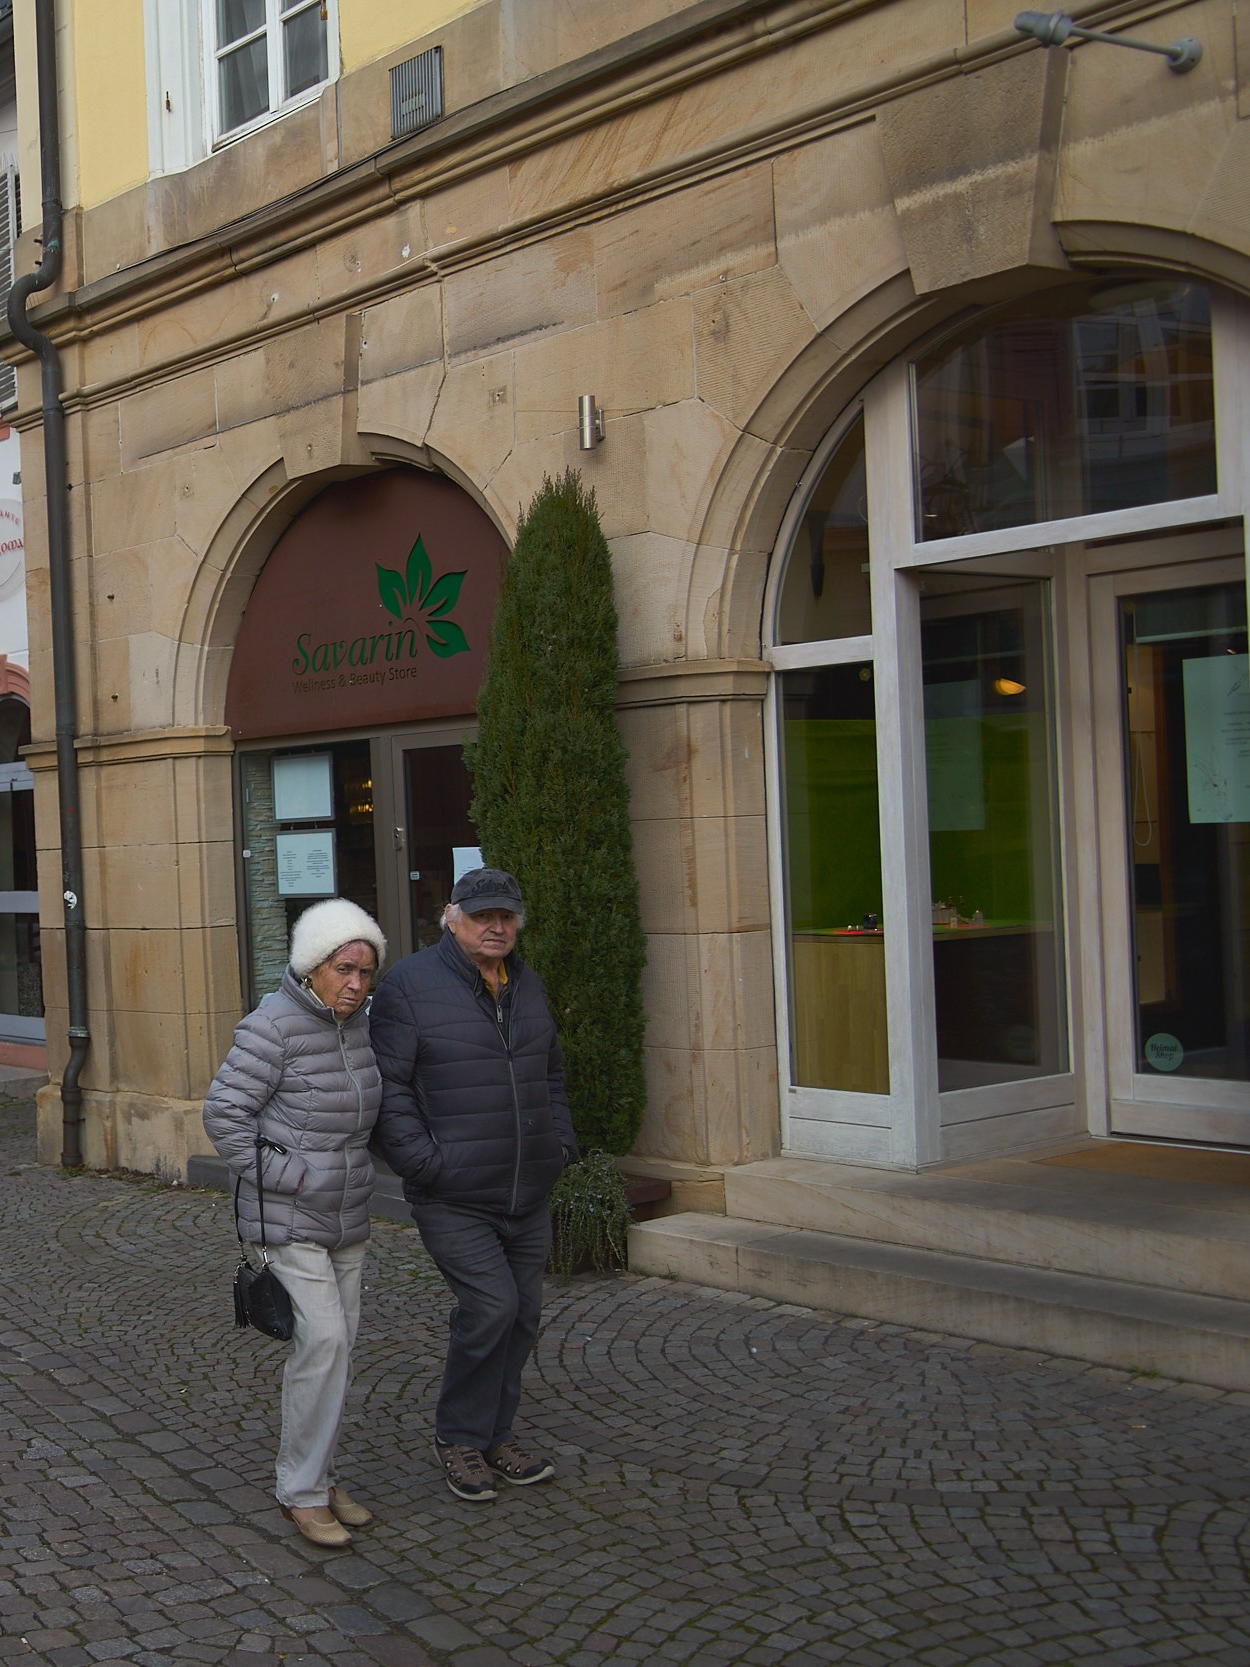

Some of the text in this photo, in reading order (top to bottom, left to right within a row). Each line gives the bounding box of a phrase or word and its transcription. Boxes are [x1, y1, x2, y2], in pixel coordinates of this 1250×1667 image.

[292, 620, 418, 676] Savarin
[292, 666, 418, 695] Wellness & Beauty Store
